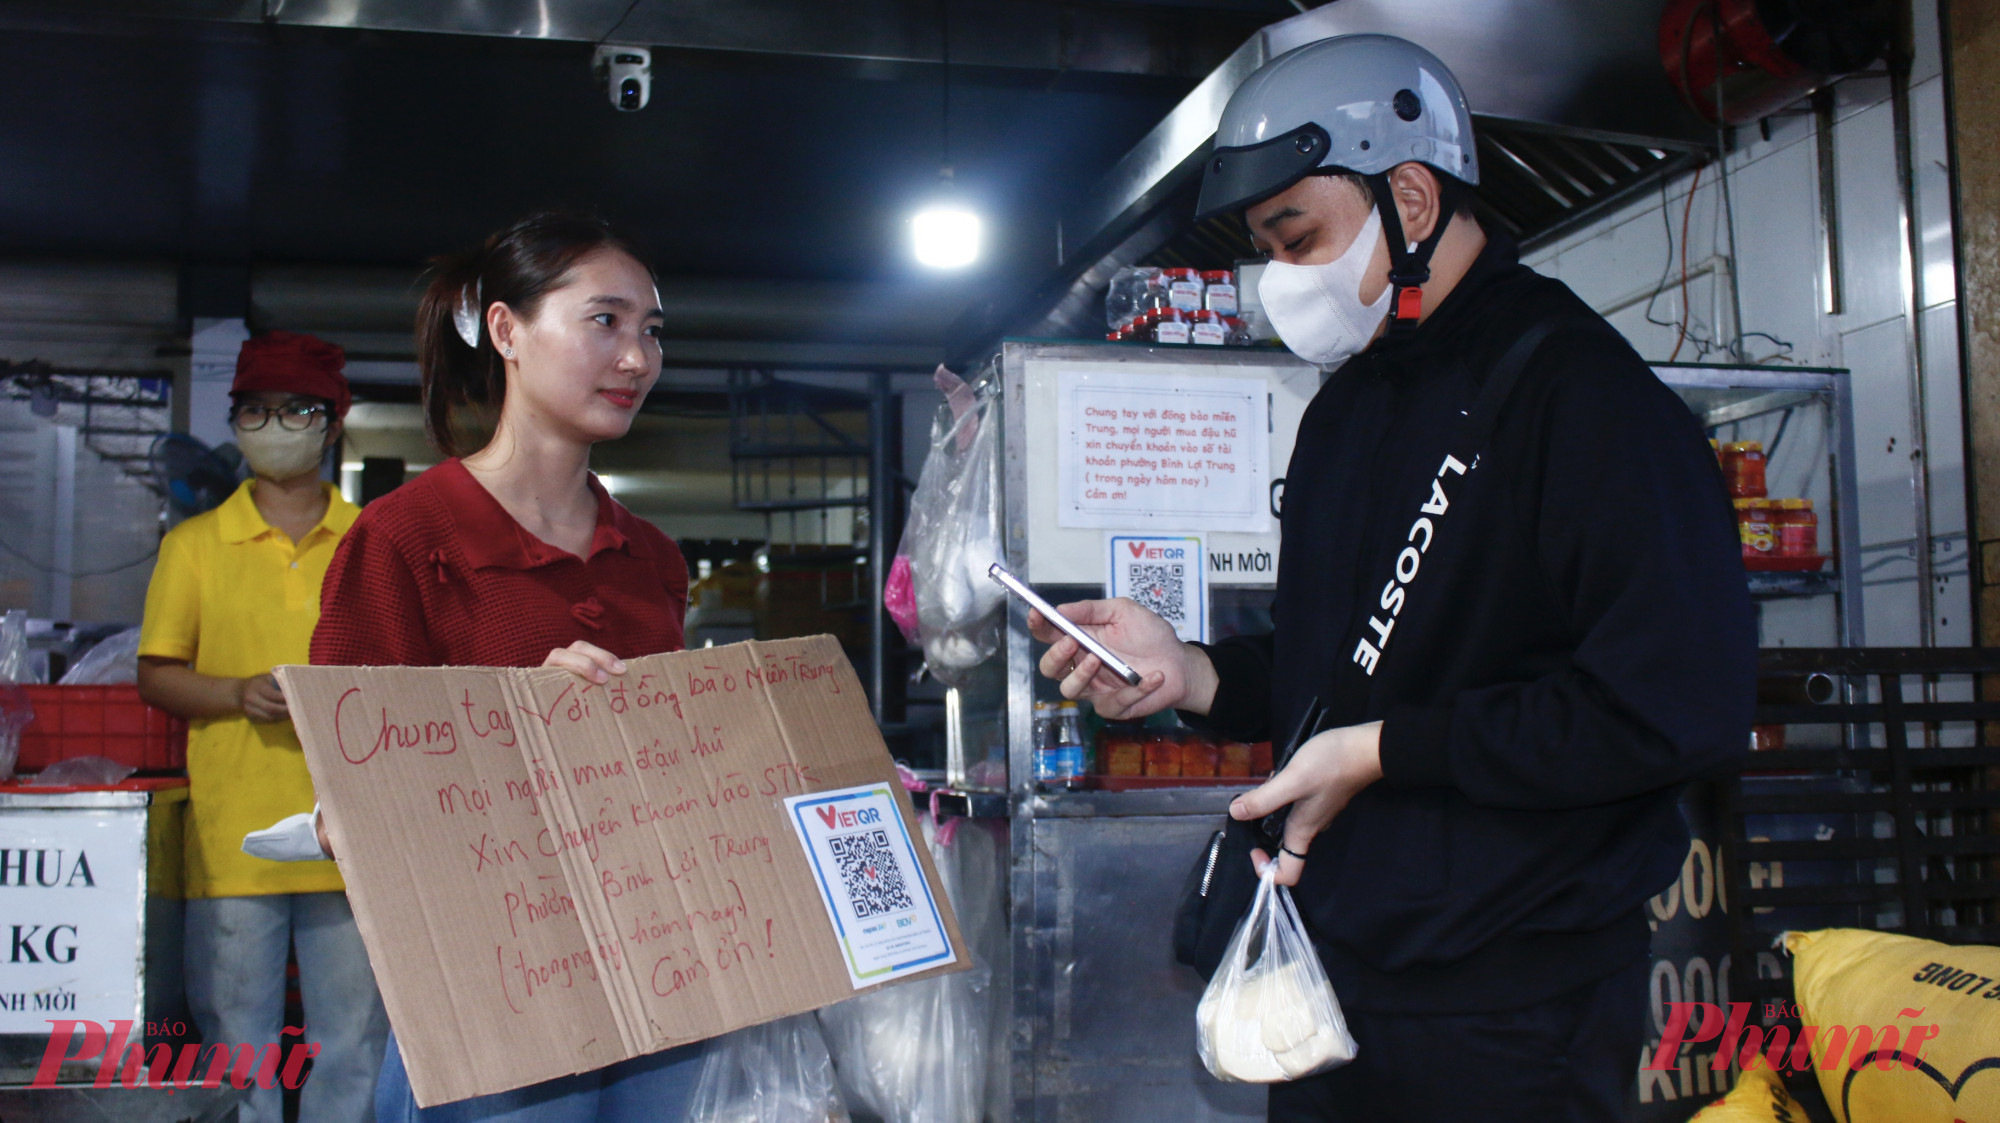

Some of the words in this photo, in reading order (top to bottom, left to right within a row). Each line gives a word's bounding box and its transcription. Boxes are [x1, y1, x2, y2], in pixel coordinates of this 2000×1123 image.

[1085, 407, 1117, 420] Chung
[1122, 409, 1138, 420] tay
[1142, 408, 1157, 419] với
[1190, 409, 1208, 421] bào
[1086, 423, 1118, 436] Trung,
[1123, 426, 1140, 438] mọi
[1144, 425, 1171, 438] người
[1176, 428, 1197, 437] mua
[1201, 427, 1220, 440] đậu
[1085, 440, 1102, 449] xin
[1106, 438, 1142, 452] chuyển
[1181, 442, 1198, 453] vào
[1202, 443, 1214, 454] số
[1218, 442, 1232, 454] tài
[1121, 457, 1157, 471] phường
[1161, 457, 1184, 469] Bình
[1188, 460, 1202, 471] Lợi
[1206, 460, 1236, 473] Trung
[1095, 473, 1123, 486] trong
[1127, 472, 1152, 487] ngày
[1181, 478, 1200, 488] nay
[1238, 548, 1272, 572] MỜI
[1353, 454, 1467, 676] LACOSTE
[335, 688, 456, 764] Chung
[461, 689, 516, 747] tay
[610, 675, 683, 719] đồng
[688, 665, 736, 697] bào
[573, 760, 628, 786] mua
[636, 738, 680, 776] đậu
[691, 726, 724, 757] hũ
[761, 763, 821, 796] STK
[816, 804, 881, 830] VIETQR
[602, 861, 654, 903] Bình
[662, 846, 698, 884] Lợi
[630, 911, 682, 944] hôm
[652, 947, 710, 997] Cảm
[33, 987, 76, 1011] MỜI
